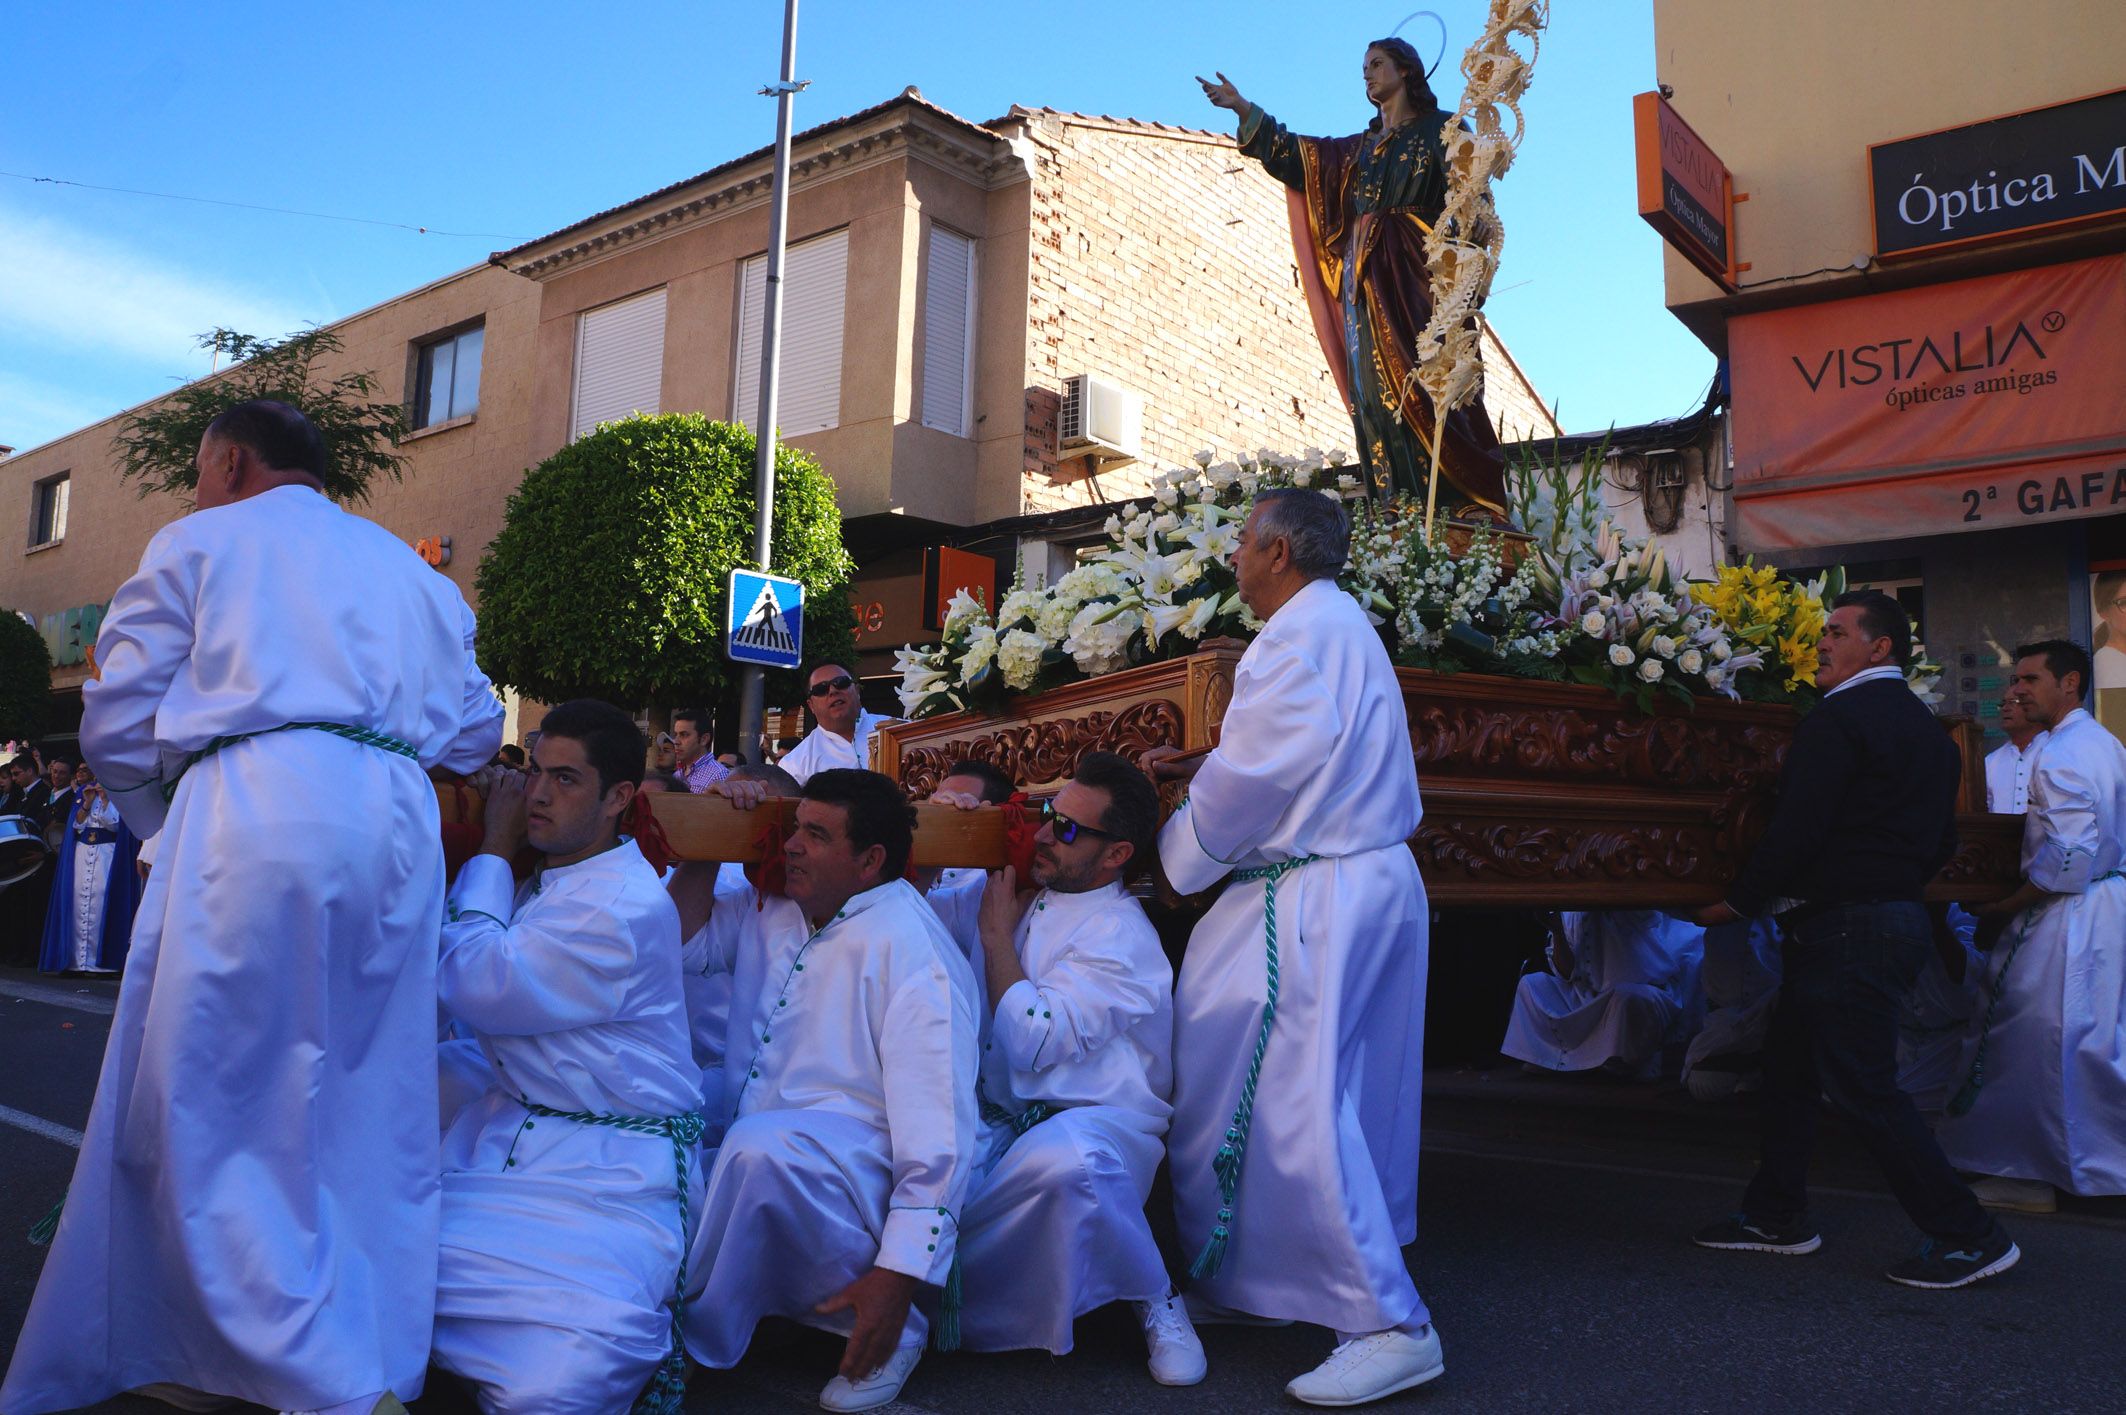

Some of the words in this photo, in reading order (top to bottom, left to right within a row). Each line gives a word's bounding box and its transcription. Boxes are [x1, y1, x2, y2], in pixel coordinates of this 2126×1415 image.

[1658, 114, 1719, 202] VISTALIA
[1898, 172, 2058, 232] Óptica
[2072, 146, 2126, 195] M
[1695, 212, 1719, 247] Mayor
[1792, 321, 2047, 393] VISTALIA
[1885, 381, 1966, 412] ópticas
[1973, 367, 2058, 396] amigas
